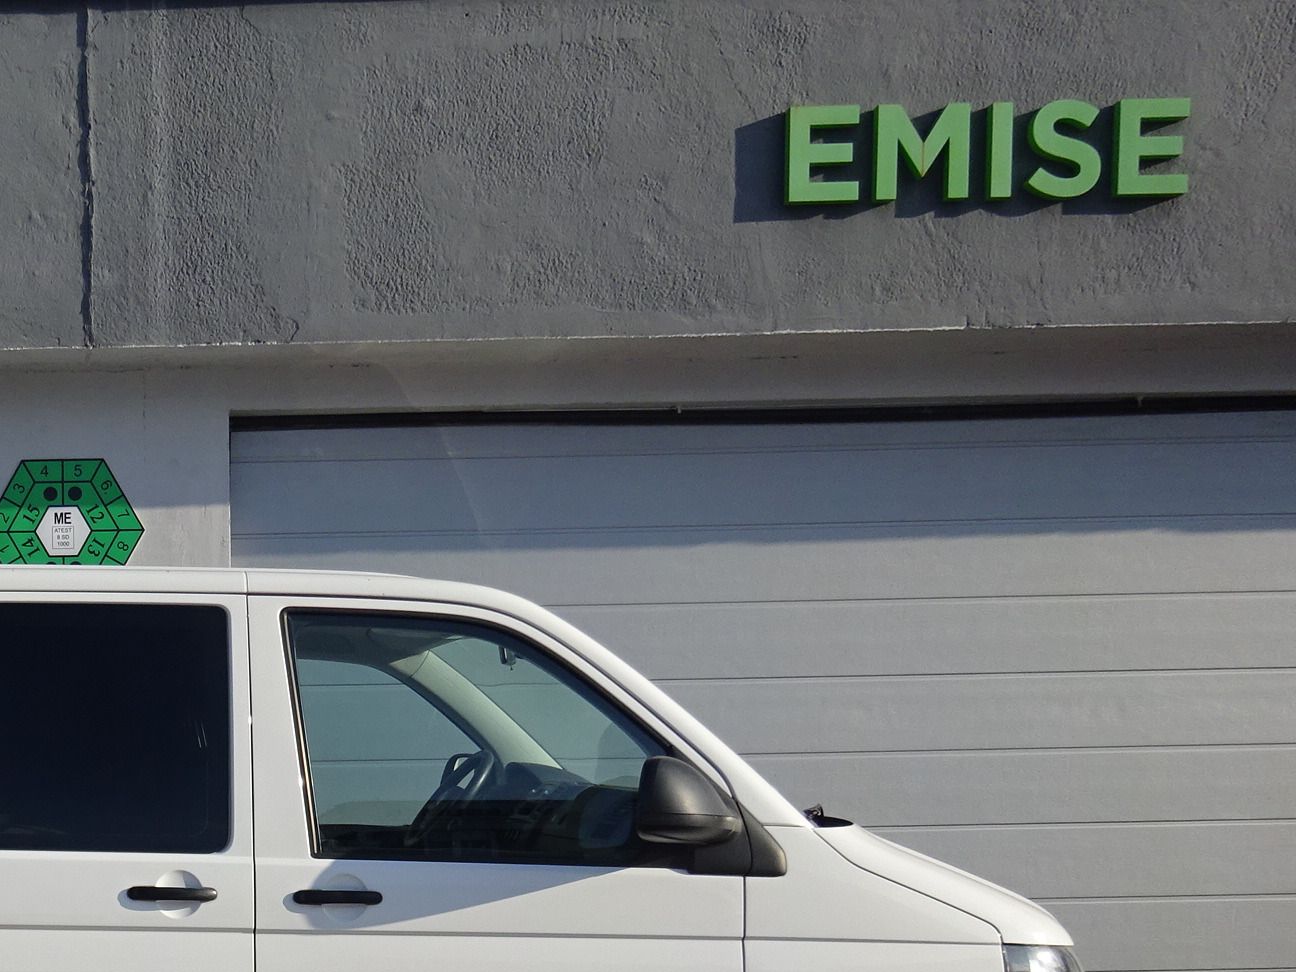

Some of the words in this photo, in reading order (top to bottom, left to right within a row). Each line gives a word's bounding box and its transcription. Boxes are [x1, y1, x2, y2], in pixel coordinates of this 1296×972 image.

[785, 98, 1191, 205] EMISE
[40, 465, 49, 477] 4
[73, 464, 83, 477] 5
[13, 483, 25, 494] 3
[22, 503, 41, 525] 15
[54, 512, 72, 525] ME
[86, 503, 105, 524] 12
[117, 508, 130, 518] 7
[0, 544, 10, 553] 1
[22, 536, 41, 558] 14
[87, 536, 106, 557] 13
[117, 541, 129, 552] 8
